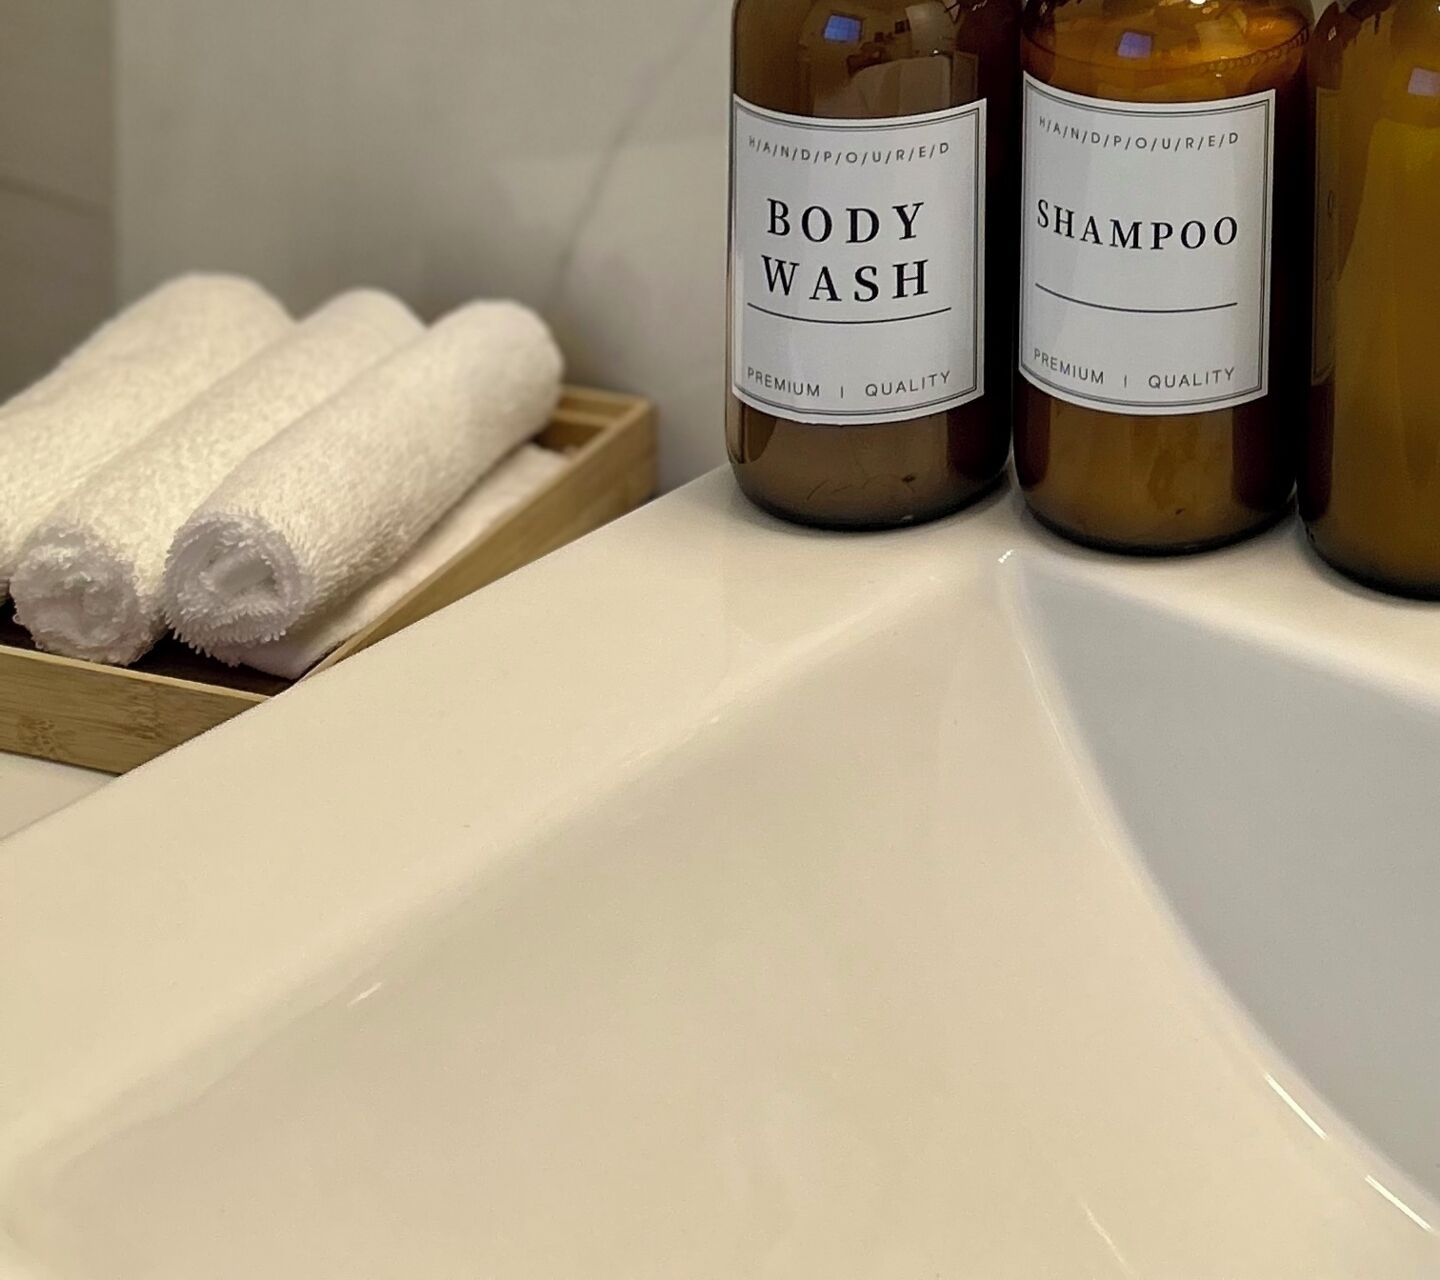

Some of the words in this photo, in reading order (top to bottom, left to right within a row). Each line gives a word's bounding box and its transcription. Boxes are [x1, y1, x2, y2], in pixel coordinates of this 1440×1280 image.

[767, 198, 925, 244] BODY
[1037, 199, 1238, 250] SHAMPOO
[761, 254, 929, 302] WASH
[747, 366, 820, 397] PREMIUM
[865, 370, 951, 397] QUALITY
[1033, 348, 1104, 385] PREMIUM
[1148, 367, 1236, 389] QUALITY
